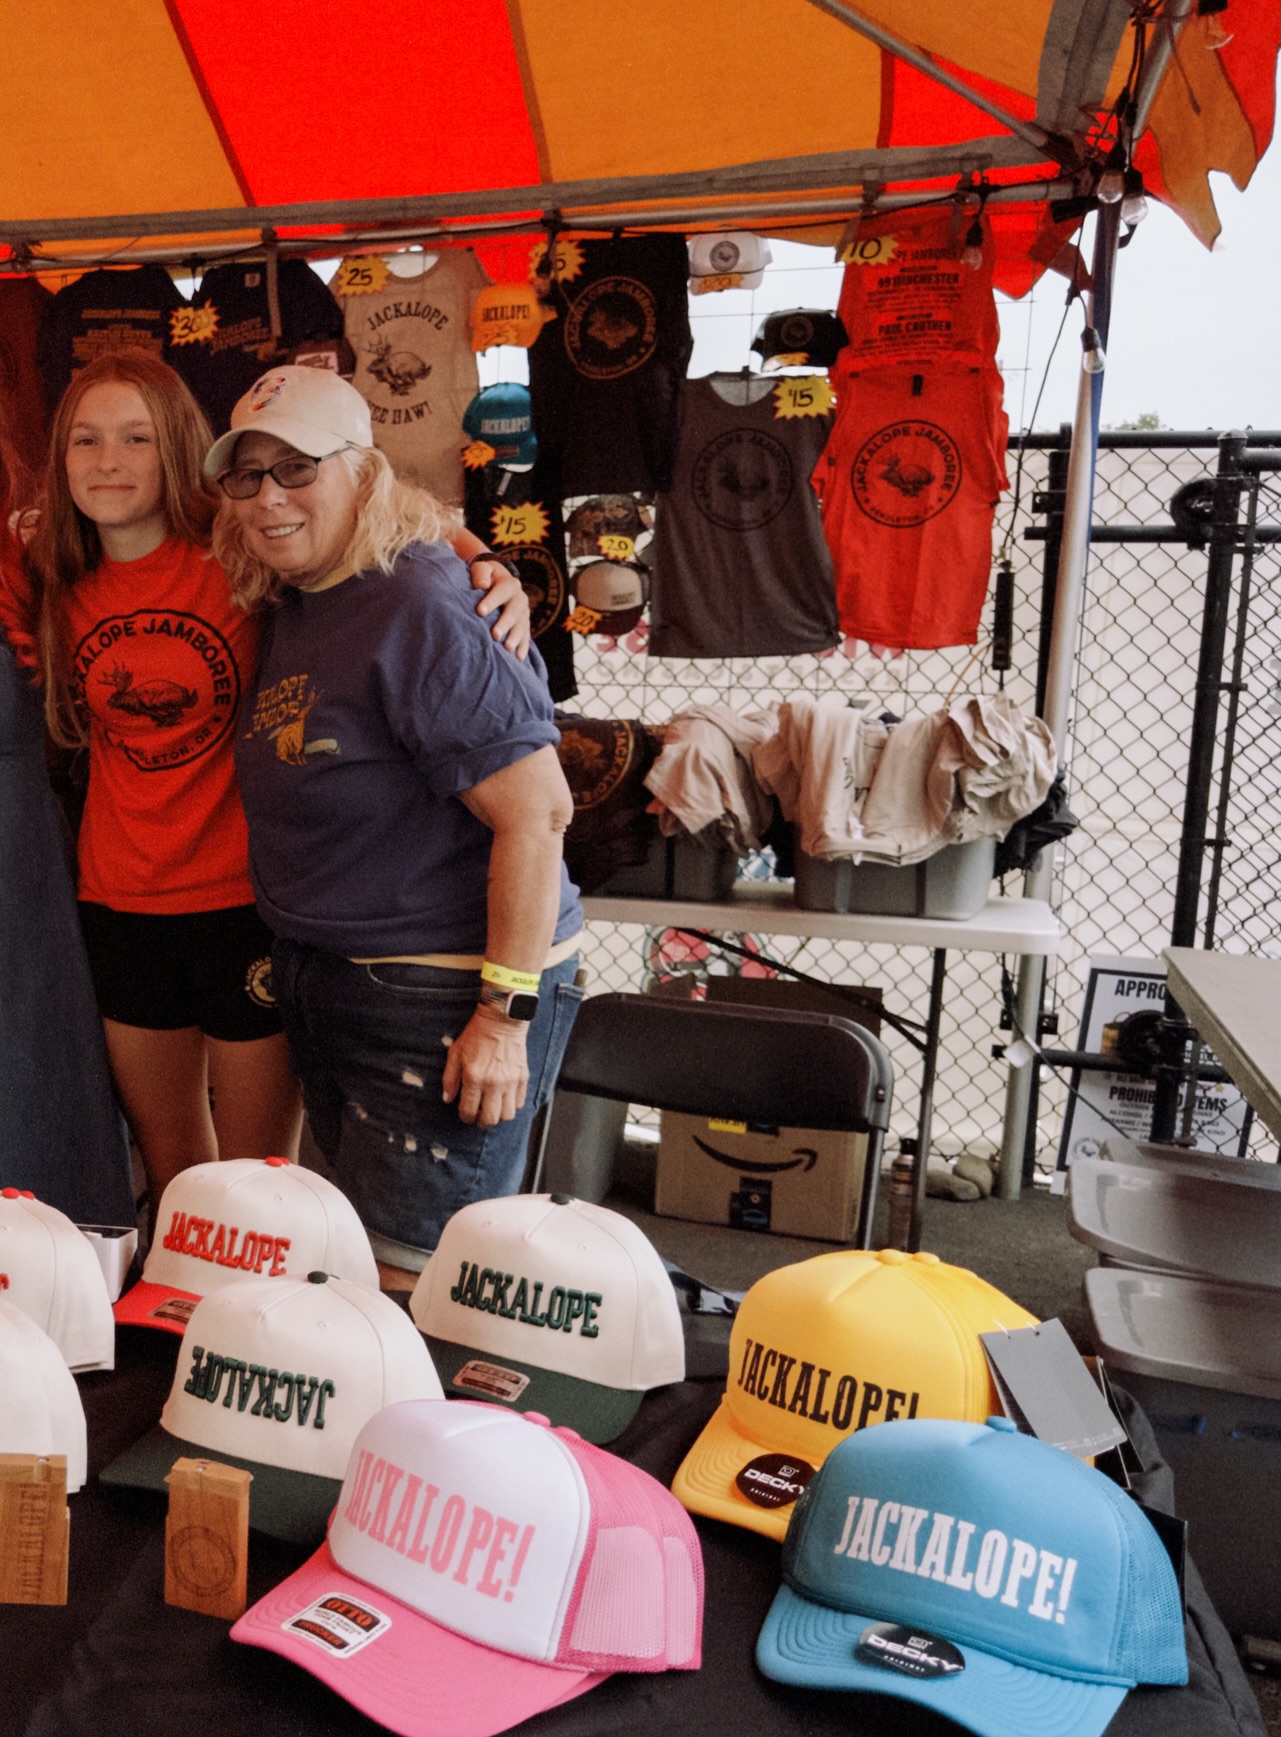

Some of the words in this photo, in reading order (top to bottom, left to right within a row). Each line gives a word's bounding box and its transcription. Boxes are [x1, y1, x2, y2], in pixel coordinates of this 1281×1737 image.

[893, 272, 960, 287] WINCHESTER
[366, 300, 450, 331] JACKALOPE
[392, 400, 433, 425] HAW!
[855, 425, 911, 493] JACKALOPE
[915, 426, 957, 492] JAMBOREE
[142, 618, 231, 706] JAMBOREE
[195, 727, 213, 744] OR
[162, 1210, 292, 1277] JACKALOPE
[450, 1259, 603, 1338] JACKALOPE
[184, 1345, 336, 1430] JACKALOPE
[737, 1337, 920, 1432] JACKALOPE!
[344, 1448, 537, 1604] JACKALOPE!
[834, 1495, 1078, 1625] JACKALOPE!
[326, 1598, 373, 1628] OTTO
[867, 1633, 964, 1671] DECKY
